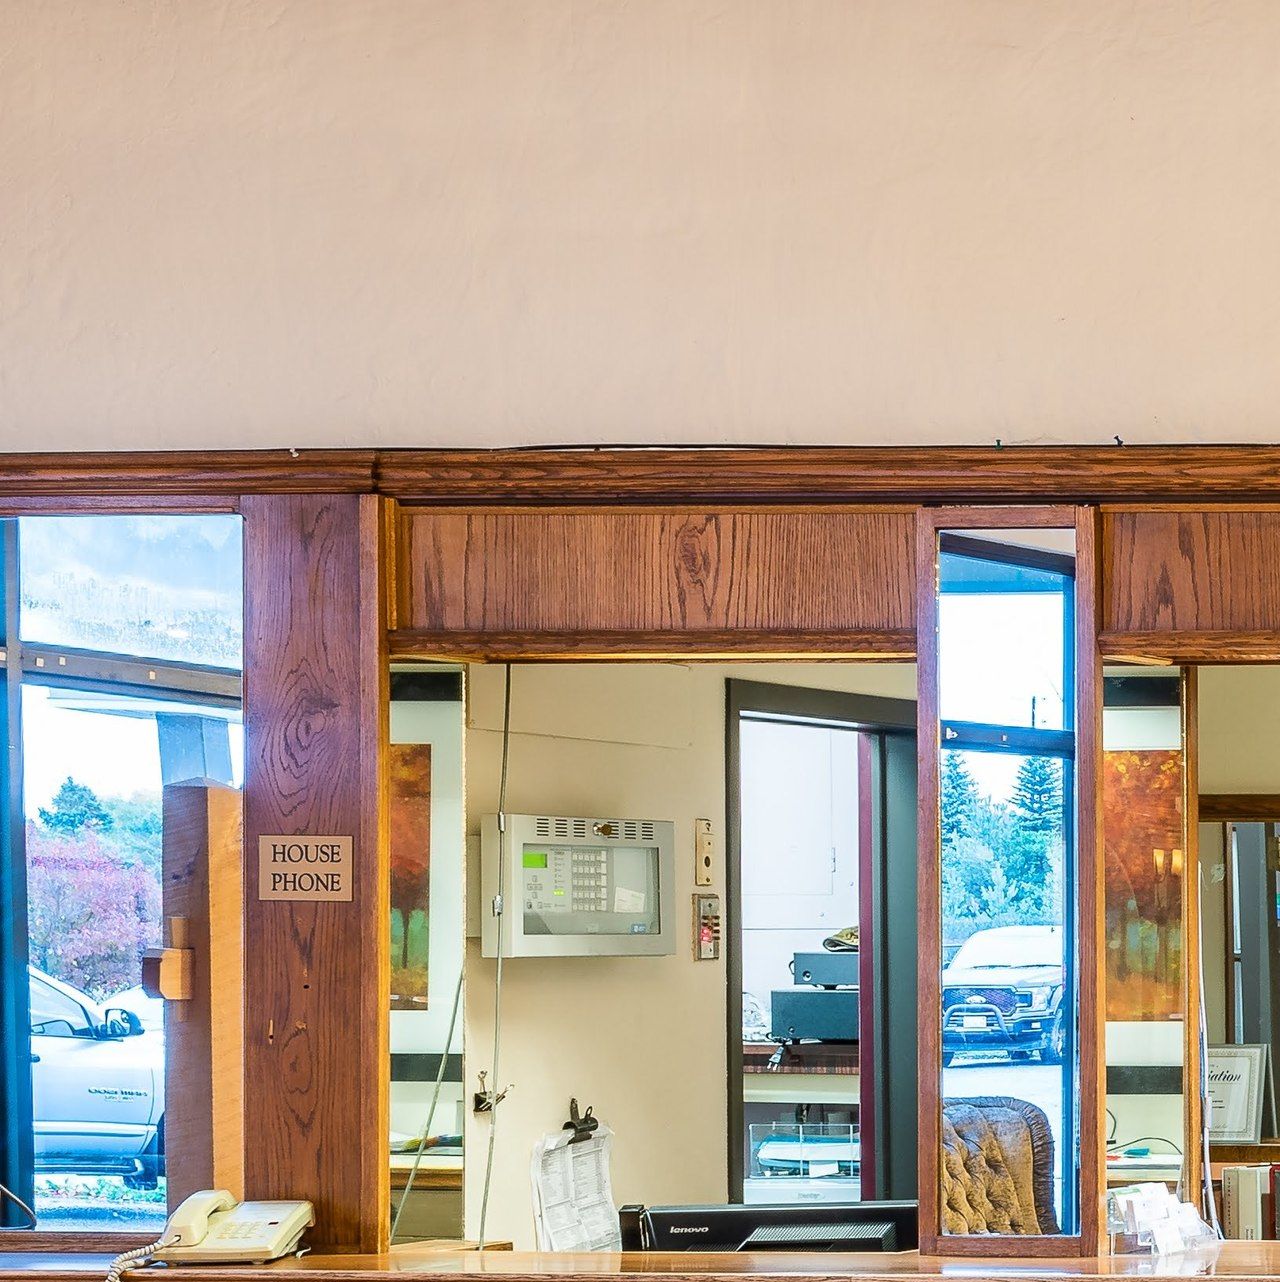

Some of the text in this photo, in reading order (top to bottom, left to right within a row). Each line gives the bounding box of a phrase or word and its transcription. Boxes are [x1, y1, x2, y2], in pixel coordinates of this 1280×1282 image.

[271, 844, 342, 863] HOUSE
[271, 873, 342, 892] PHONE
[670, 1226, 709, 1234] lenovo
